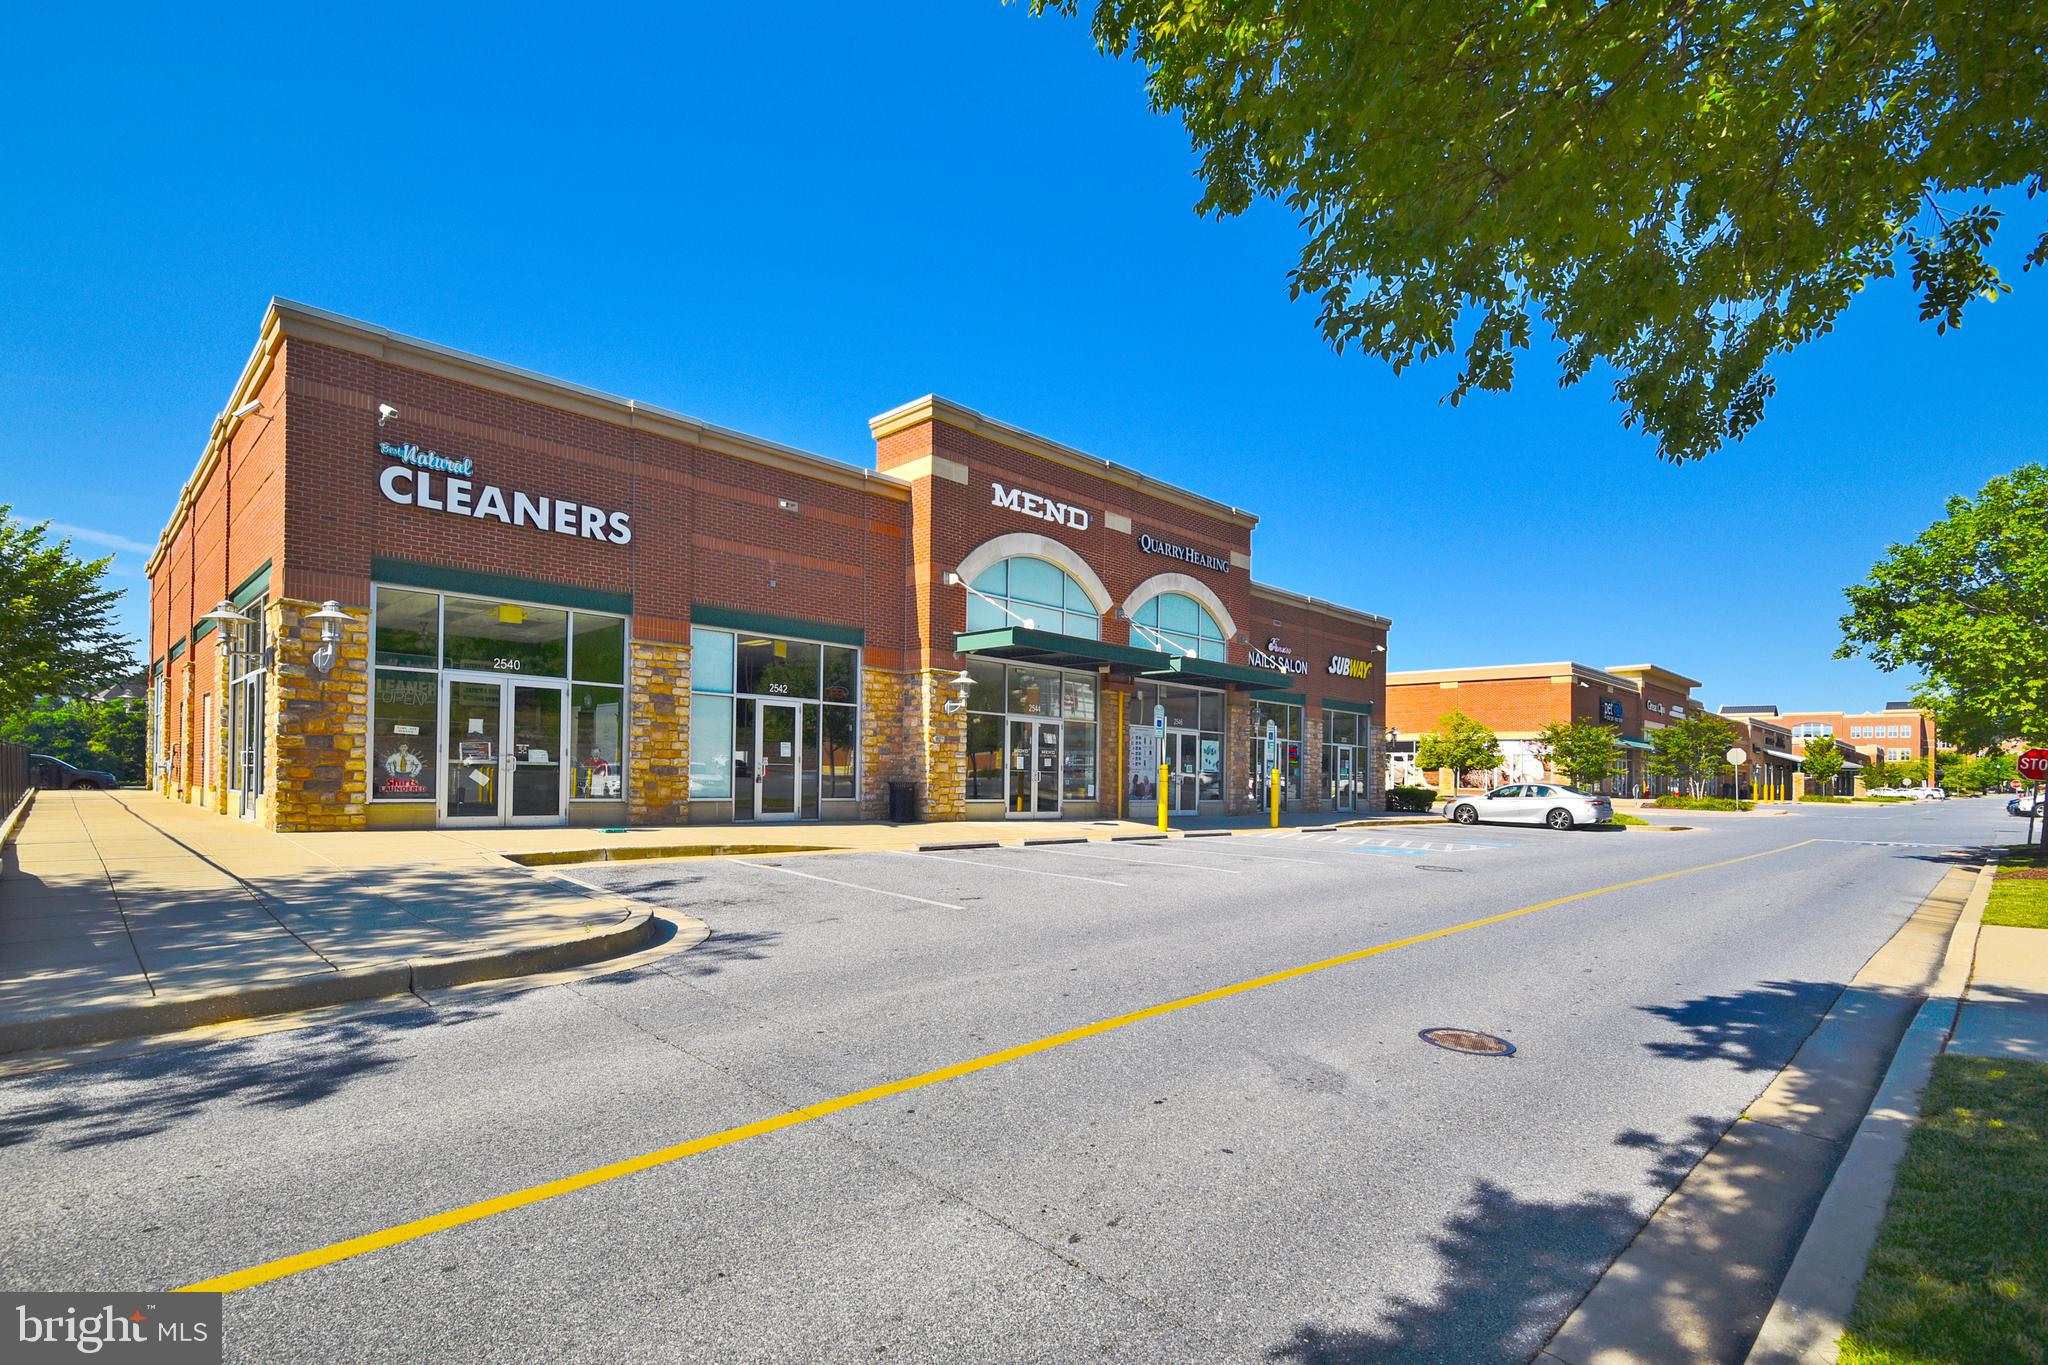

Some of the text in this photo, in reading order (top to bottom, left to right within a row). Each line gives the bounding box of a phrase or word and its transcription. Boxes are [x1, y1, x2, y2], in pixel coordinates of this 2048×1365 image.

[402, 443, 473, 476] Natural
[379, 466, 632, 545] CLEANERS
[992, 482, 1089, 531] MEND
[1140, 534, 1229, 573] QUARRY HEARING
[493, 658, 521, 671] 2540
[1248, 651, 1308, 675] NAILS SALON
[1328, 655, 1373, 680] SUBWAY
[769, 683, 788, 694] 2542
[2020, 757, 2048, 771] STO
